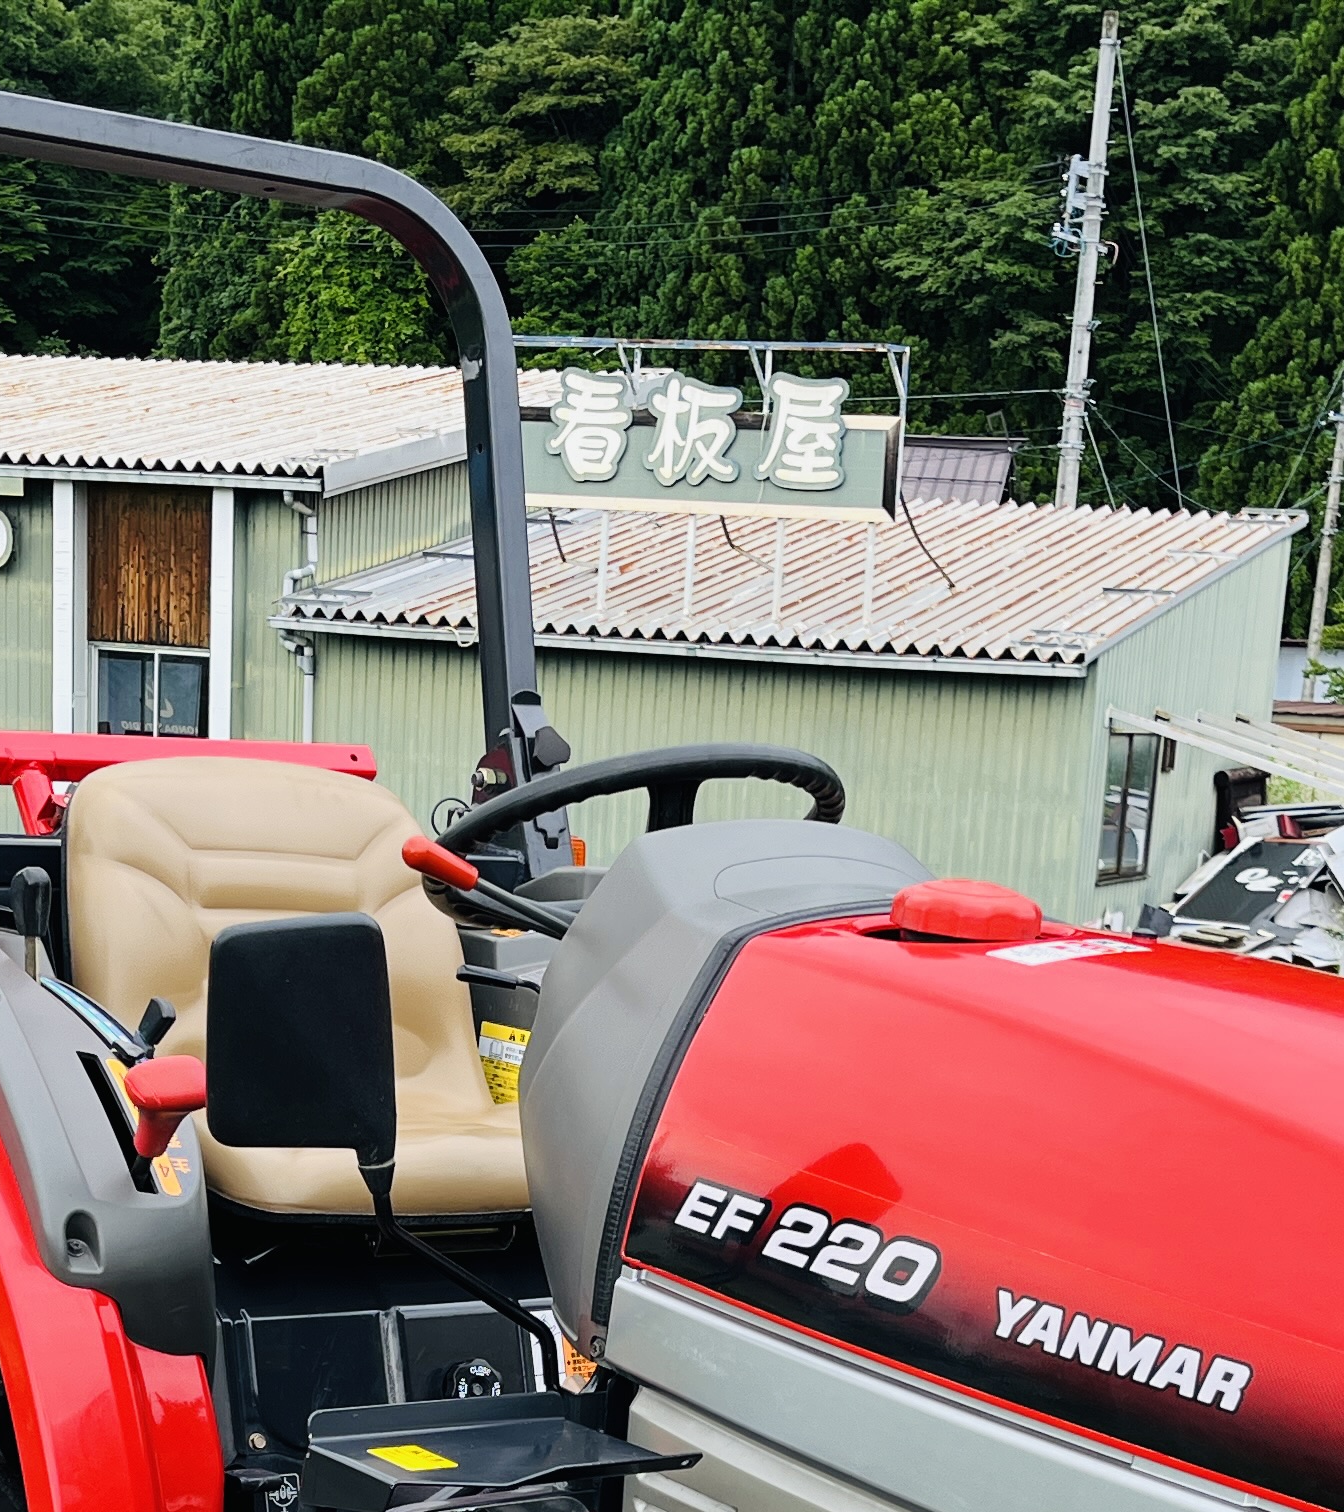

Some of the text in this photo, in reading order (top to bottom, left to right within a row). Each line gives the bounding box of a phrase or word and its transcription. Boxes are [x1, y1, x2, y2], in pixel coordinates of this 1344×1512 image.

[548, 370, 846, 486] 看板屋
[673, 1180, 940, 1303] EF 220
[995, 1288, 1254, 1413] YANMAR
